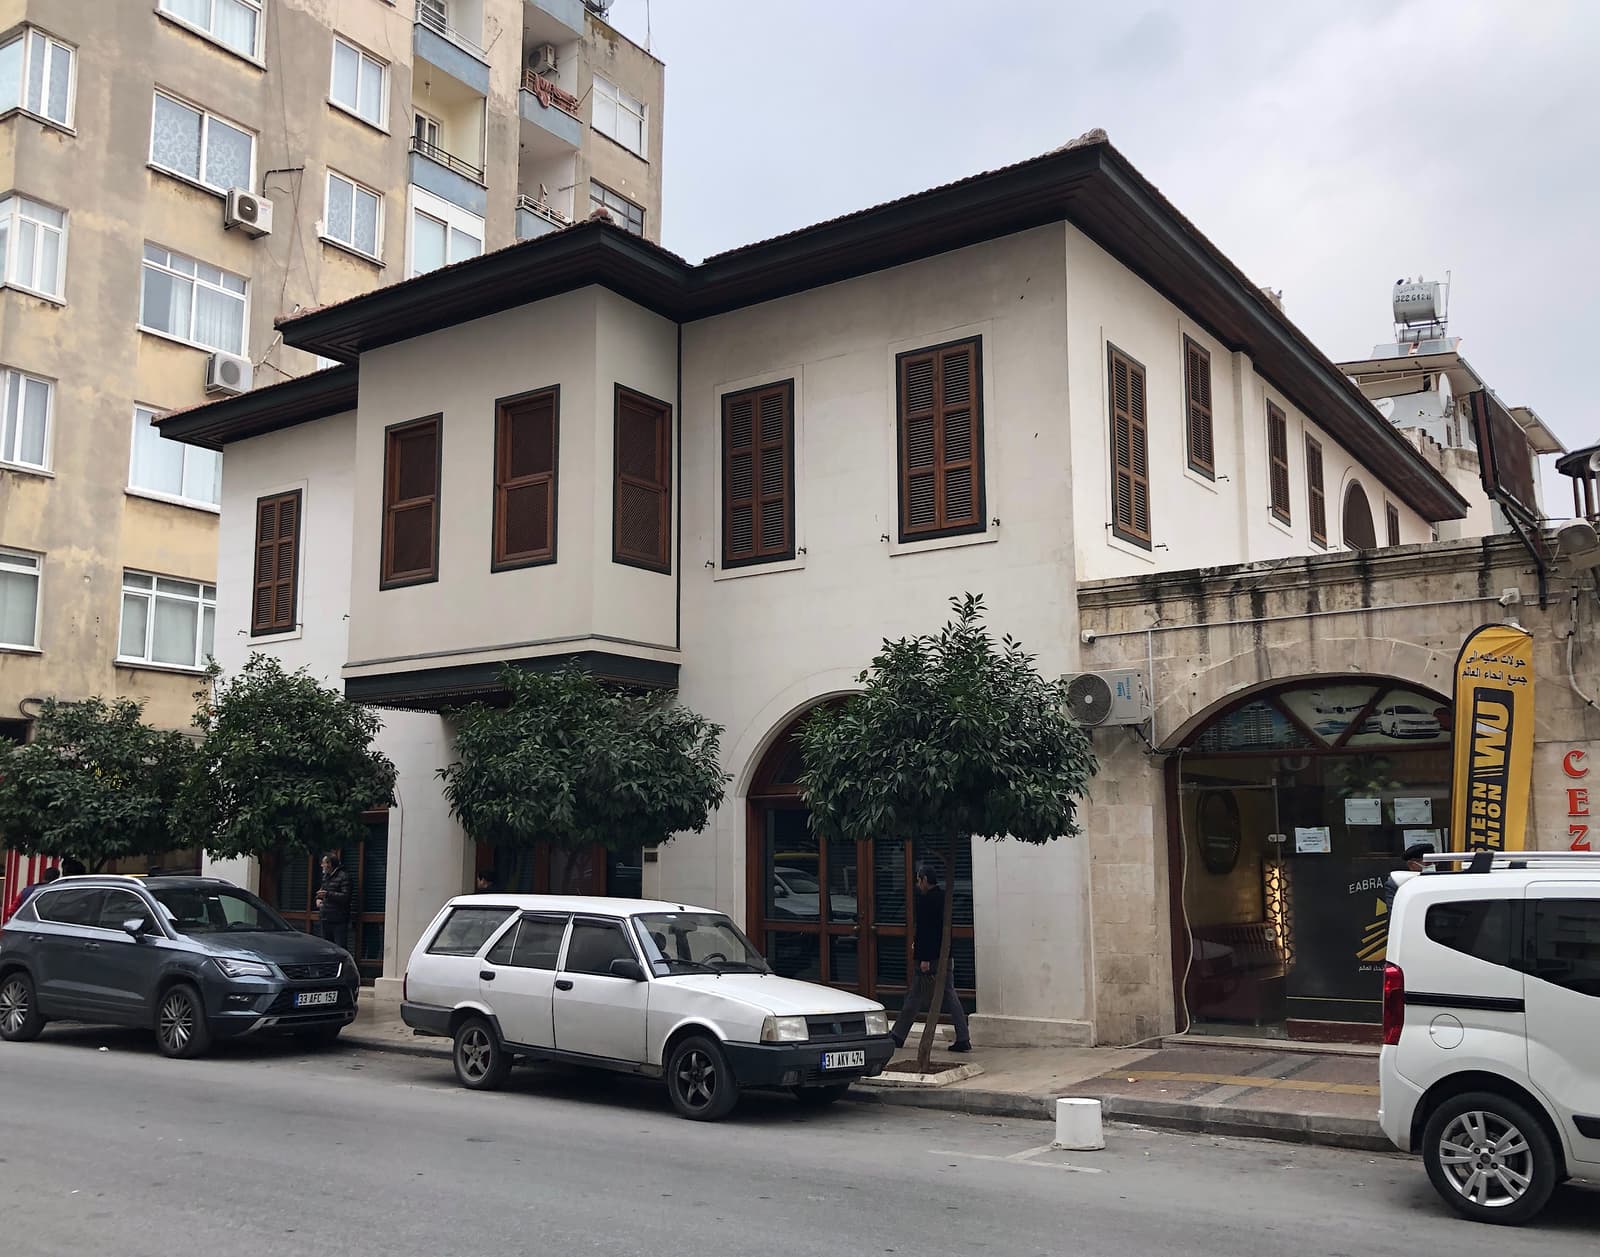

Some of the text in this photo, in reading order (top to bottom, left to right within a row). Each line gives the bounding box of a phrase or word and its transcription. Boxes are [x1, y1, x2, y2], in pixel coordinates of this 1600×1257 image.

[1474, 701, 1510, 768] WU
[299, 994, 308, 1004] 33
[826, 1054, 834, 1067] 31
[851, 1052, 864, 1064] 474
